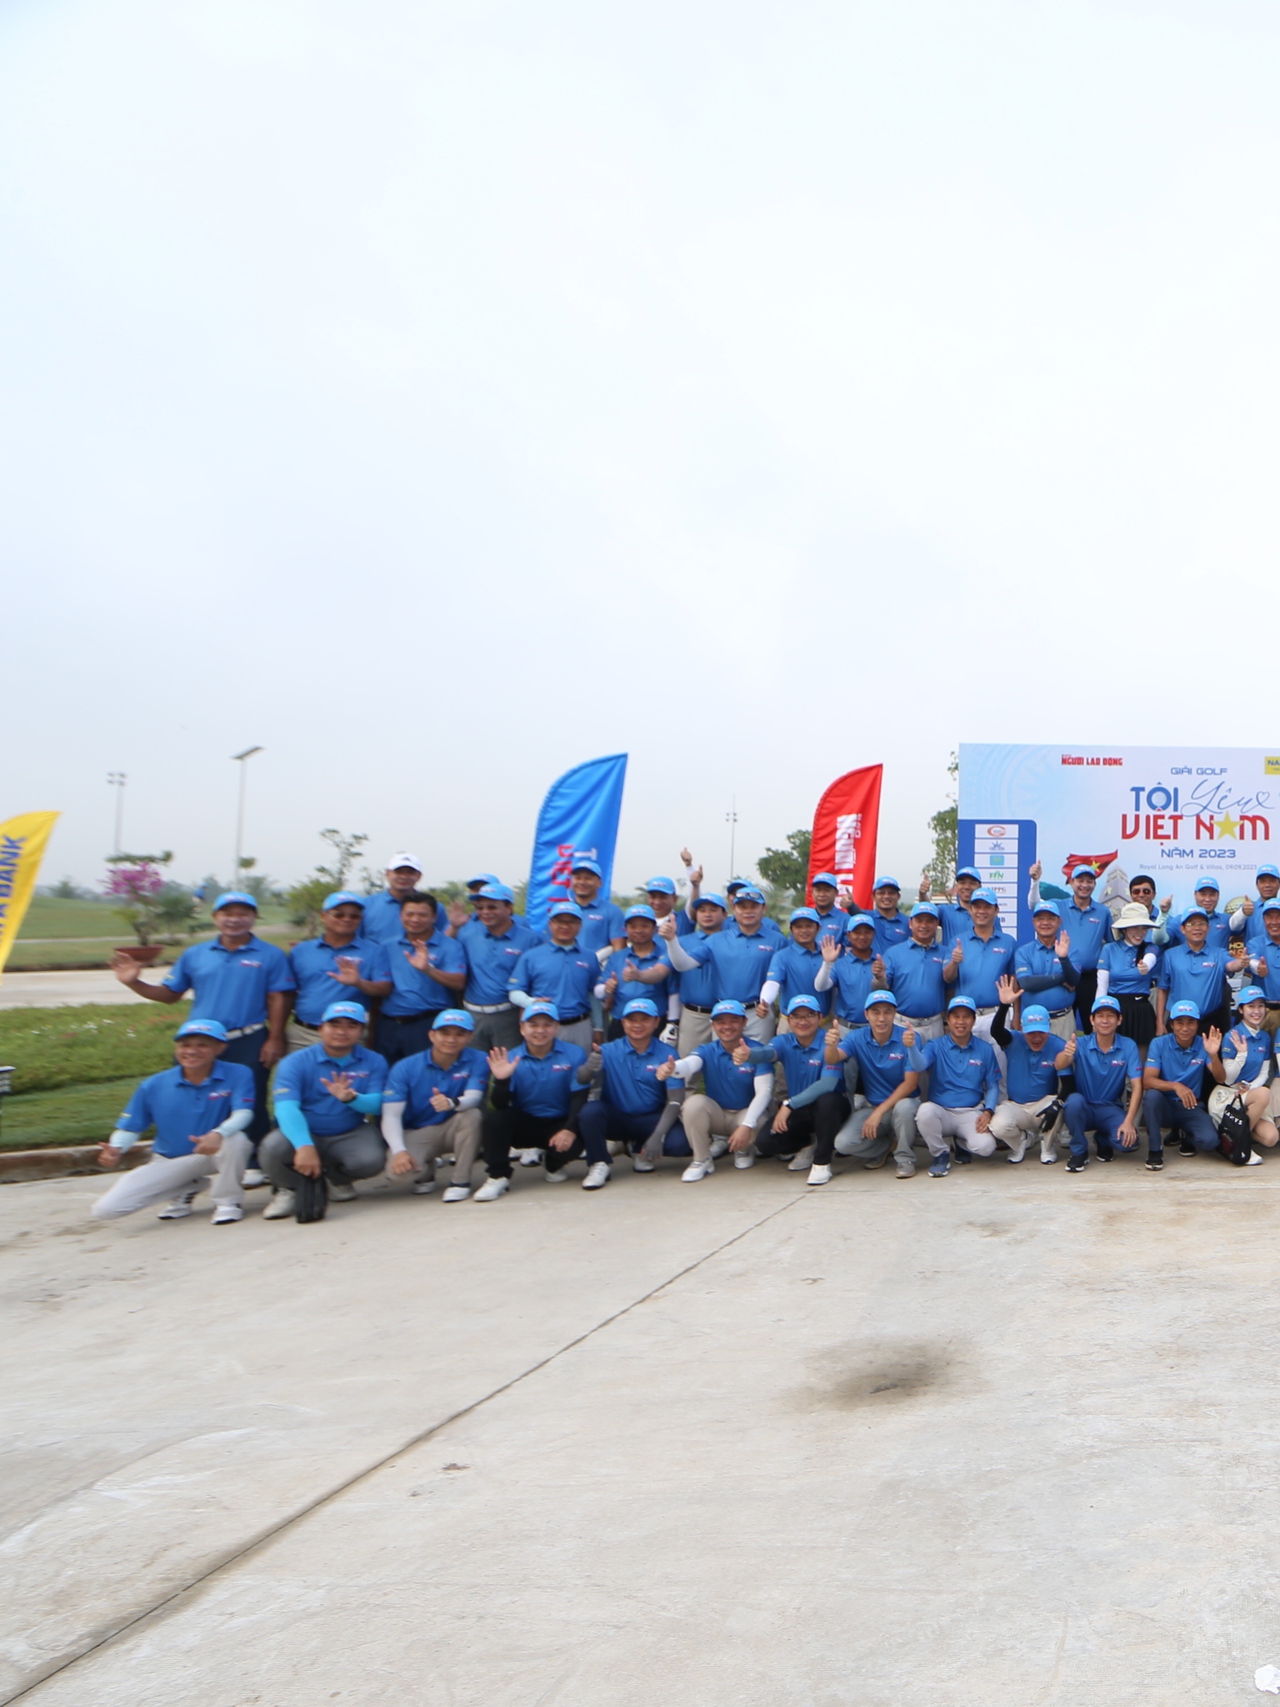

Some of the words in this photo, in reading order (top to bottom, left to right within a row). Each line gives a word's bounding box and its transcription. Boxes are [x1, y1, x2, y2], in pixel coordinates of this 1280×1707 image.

[1196, 767, 1228, 775] GOLF
[1130, 781, 1179, 812] TÔI
[1121, 809, 1184, 846] VIỆT
[1198, 849, 1236, 858] 2023
